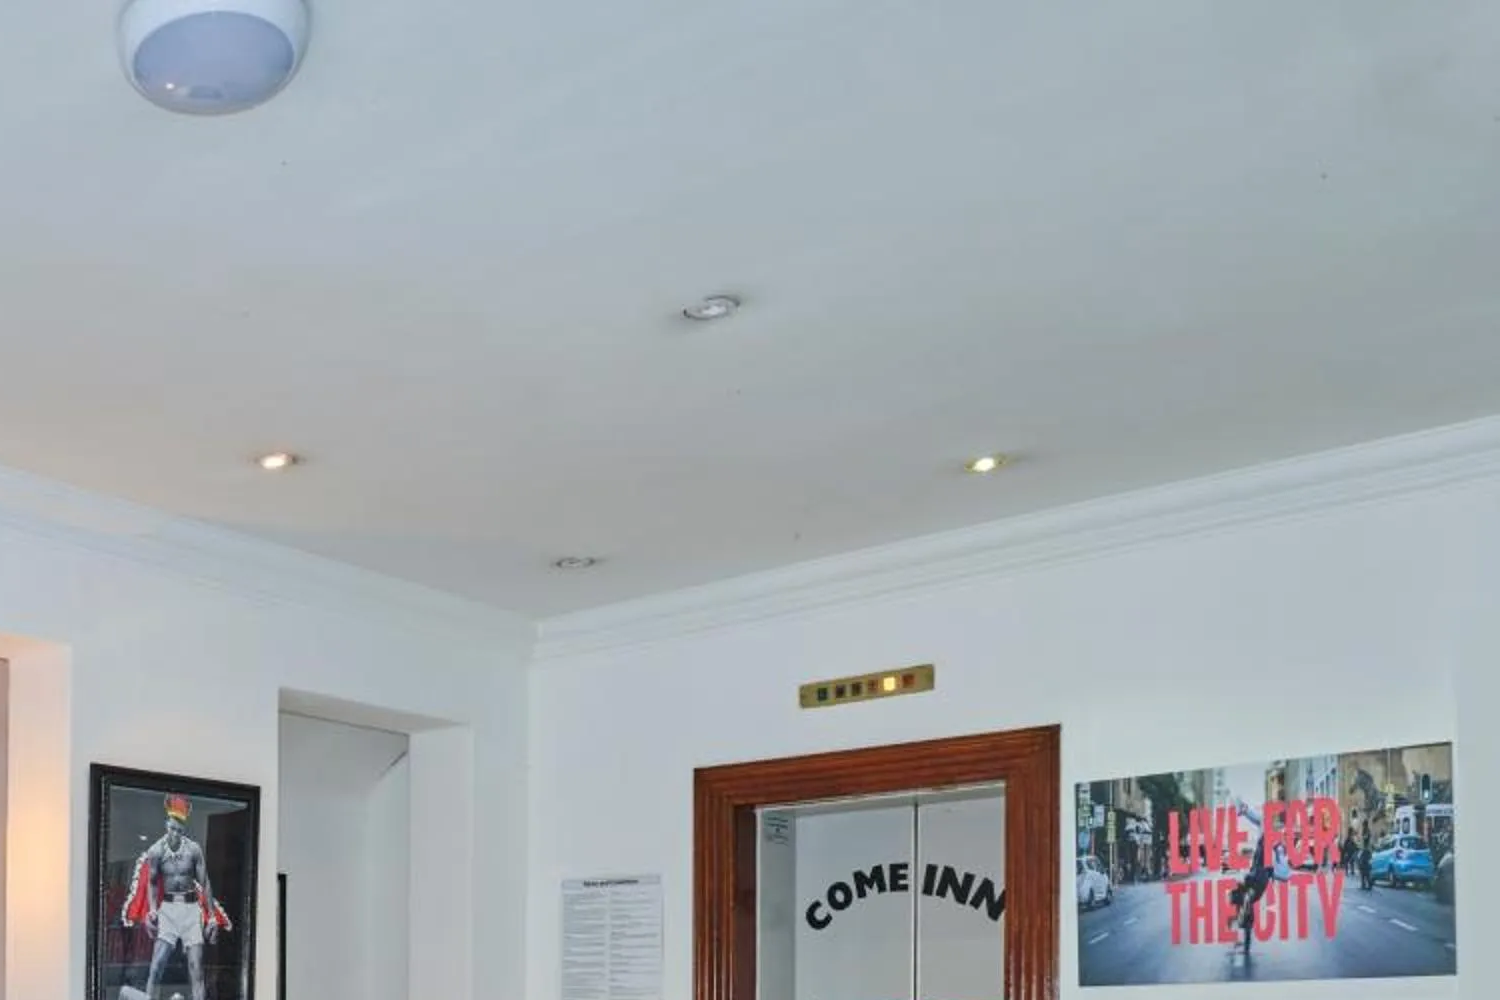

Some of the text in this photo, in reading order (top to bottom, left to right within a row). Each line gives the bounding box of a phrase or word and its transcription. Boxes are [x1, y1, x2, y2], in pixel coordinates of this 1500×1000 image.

[1168, 796, 1342, 875] LIVE FOR
[806, 863, 1006, 931] COME INN
[1164, 868, 1346, 946] THE CITY
